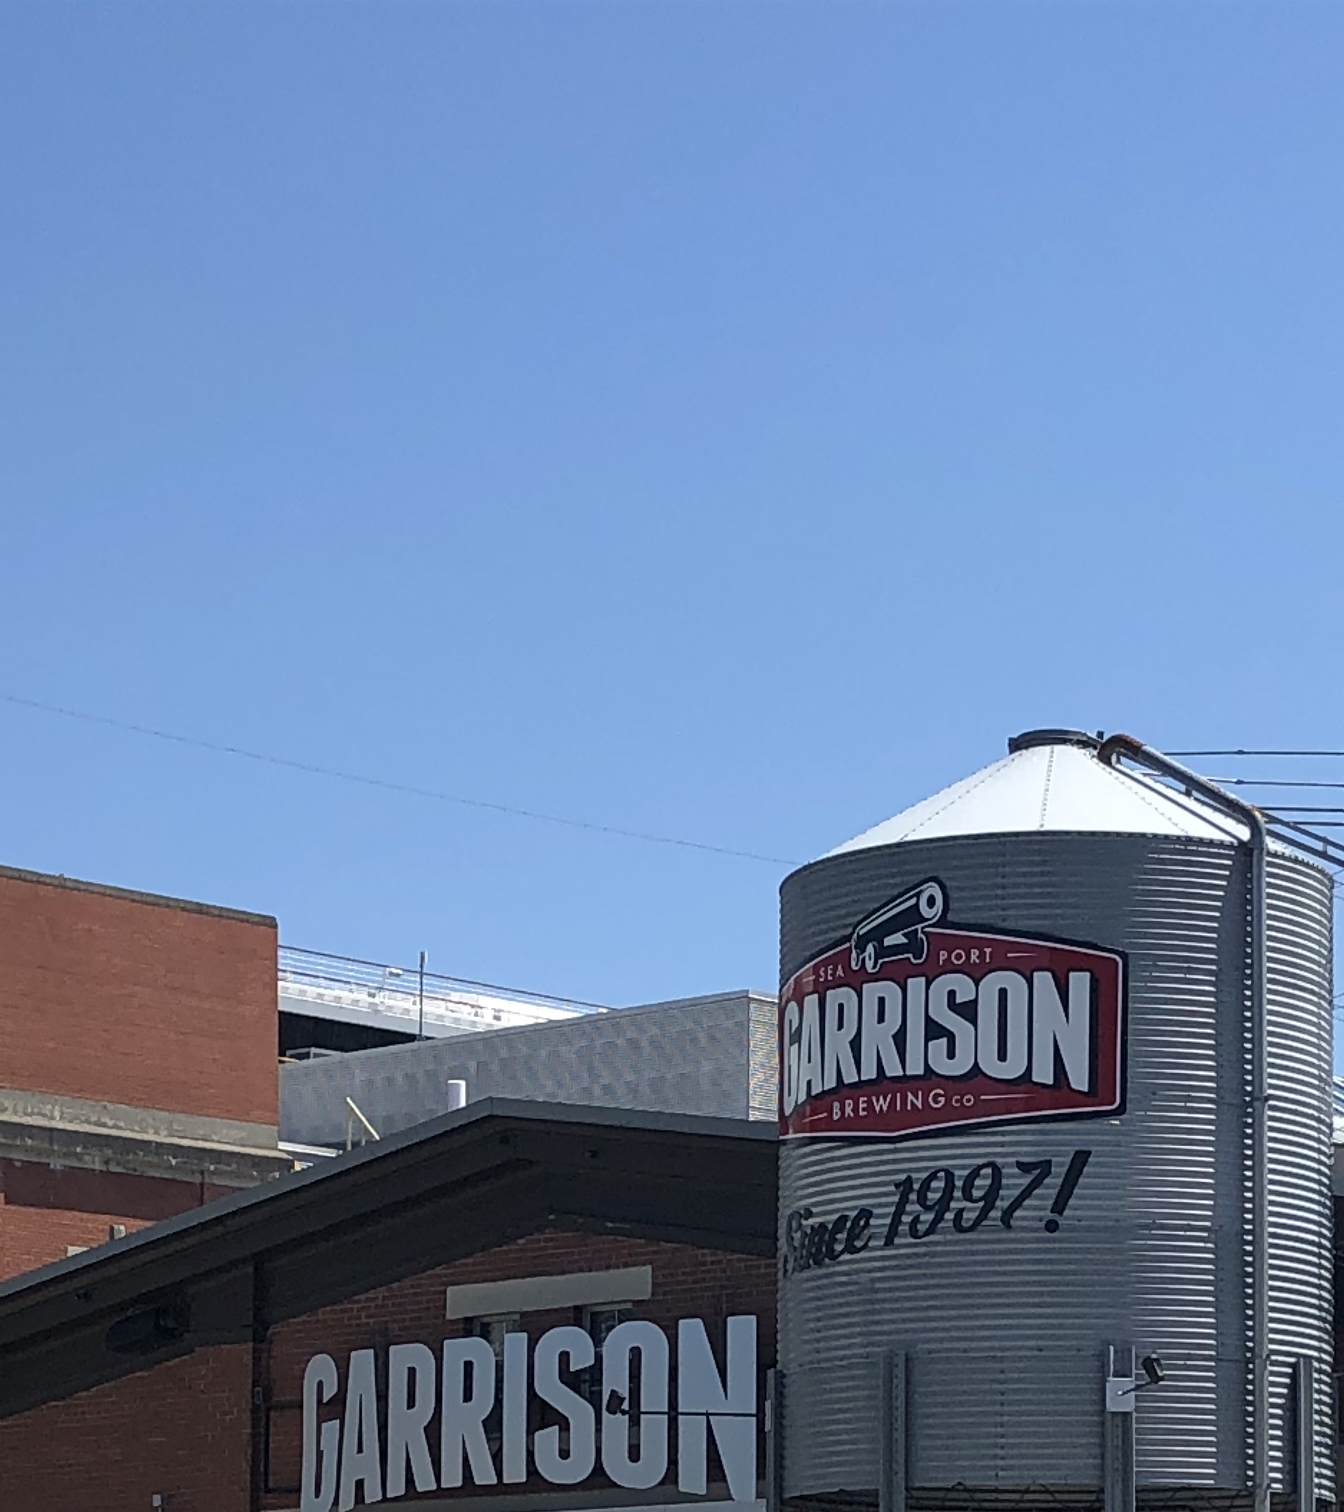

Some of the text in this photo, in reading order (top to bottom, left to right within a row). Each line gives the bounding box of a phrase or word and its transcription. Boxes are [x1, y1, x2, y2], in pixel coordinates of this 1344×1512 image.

[818, 948, 993, 982] SEA PORT
[783, 970, 1092, 1117] GARRISON
[832, 1089, 946, 1121] BREWING
[783, 1150, 1093, 1277] Since 1997!
